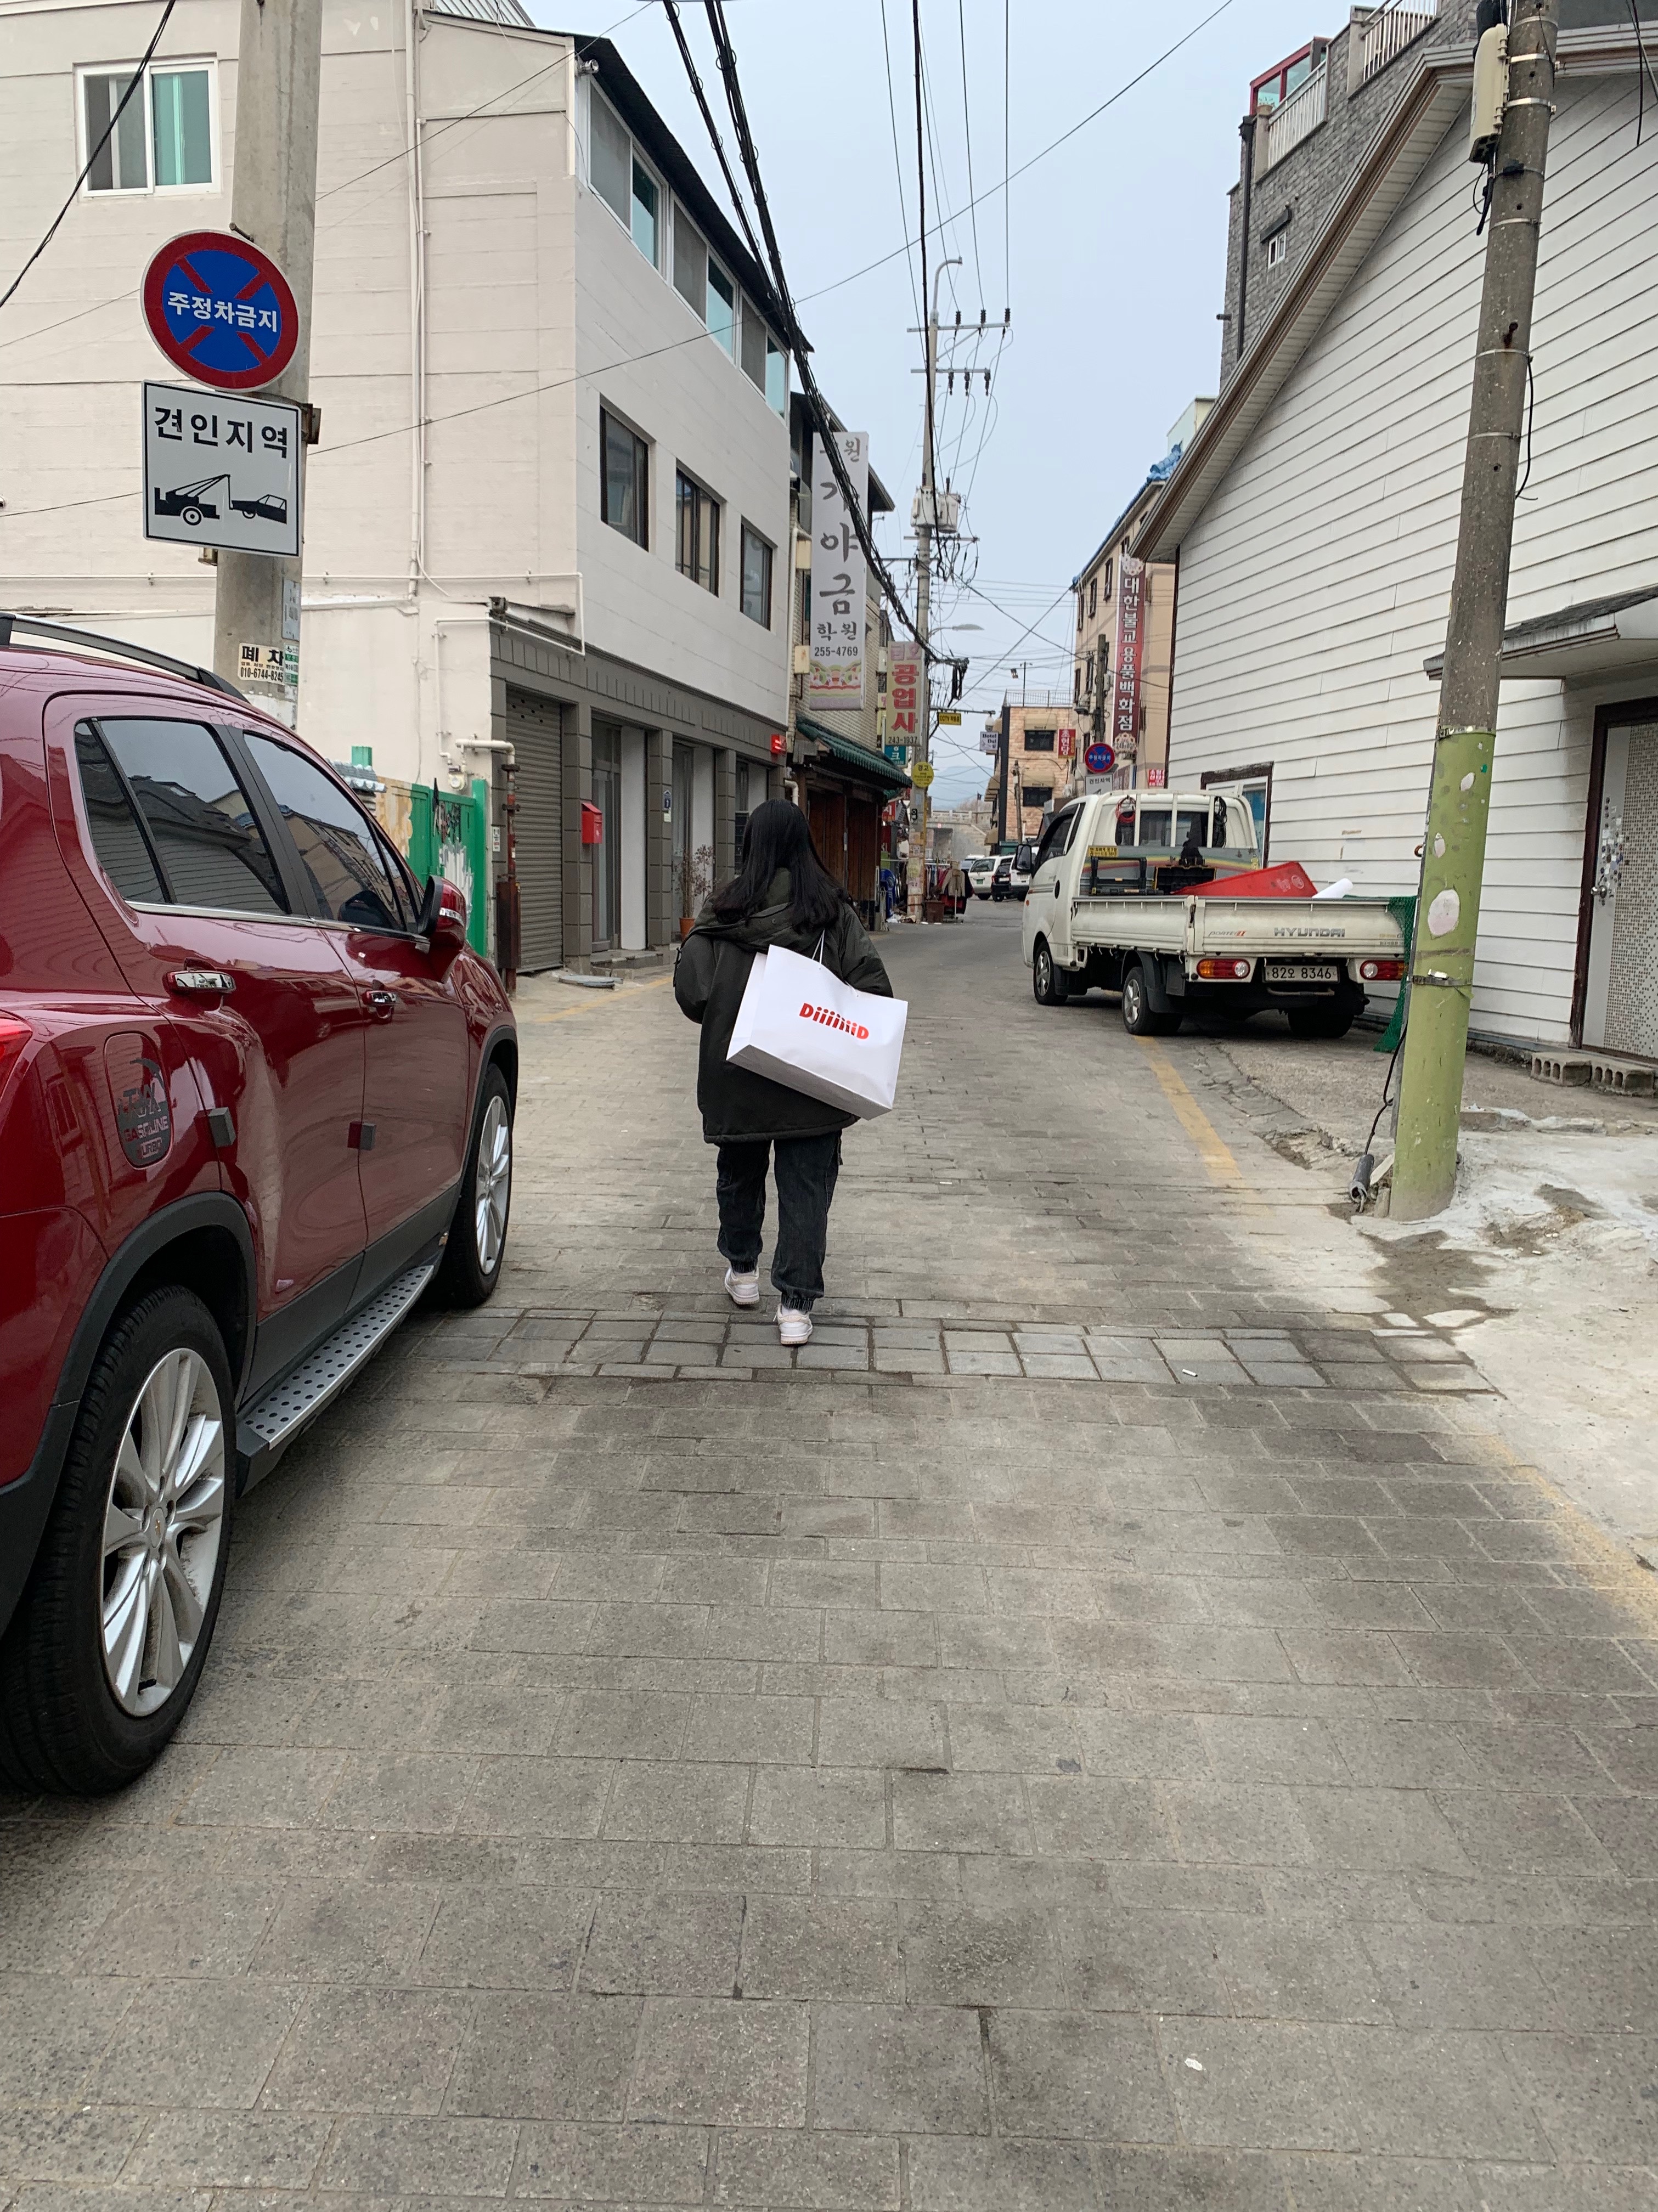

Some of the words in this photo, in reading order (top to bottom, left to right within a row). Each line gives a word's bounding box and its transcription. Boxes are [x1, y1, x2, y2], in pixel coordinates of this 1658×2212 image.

[167, 291, 278, 333] 주정차금지
[154, 406, 288, 459] 견인지역
[816, 620, 857, 641] 학원
[814, 646, 858, 657] 255-4769
[891, 664, 920, 734] 공업사
[888, 736, 918, 744] 243-1937
[1274, 928, 1345, 937] HYUNDAI
[1272, 967, 1295, 979] 82오
[1301, 967, 1331, 979] 8346
